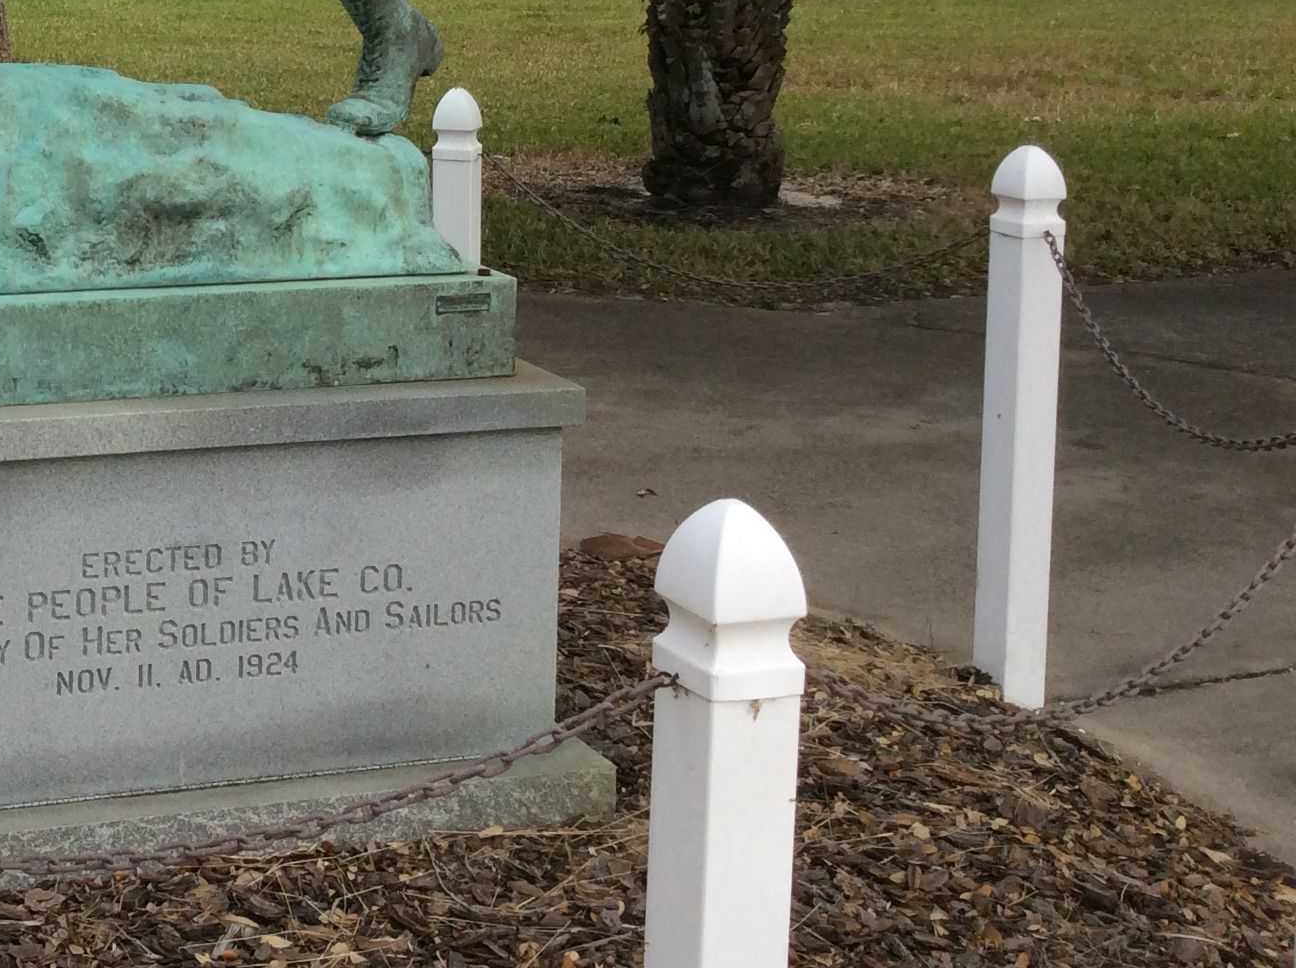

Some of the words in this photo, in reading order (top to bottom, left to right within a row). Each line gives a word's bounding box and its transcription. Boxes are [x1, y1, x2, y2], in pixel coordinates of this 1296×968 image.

[81, 543, 223, 579] ERECTED
[241, 539, 275, 566] BY
[27, 582, 166, 623] PEOPLE
[188, 576, 234, 608] OF
[253, 568, 339, 603] LAKE
[360, 563, 413, 594] CO.
[24, 631, 65, 661] OF
[82, 626, 142, 656] HER
[158, 615, 300, 649] SOLDIERS
[314, 606, 370, 636] AND
[384, 598, 502, 629] SAILORS
[56, 666, 120, 696] NOV.
[178, 658, 221, 684] AD.
[238, 650, 299, 679] 1924
